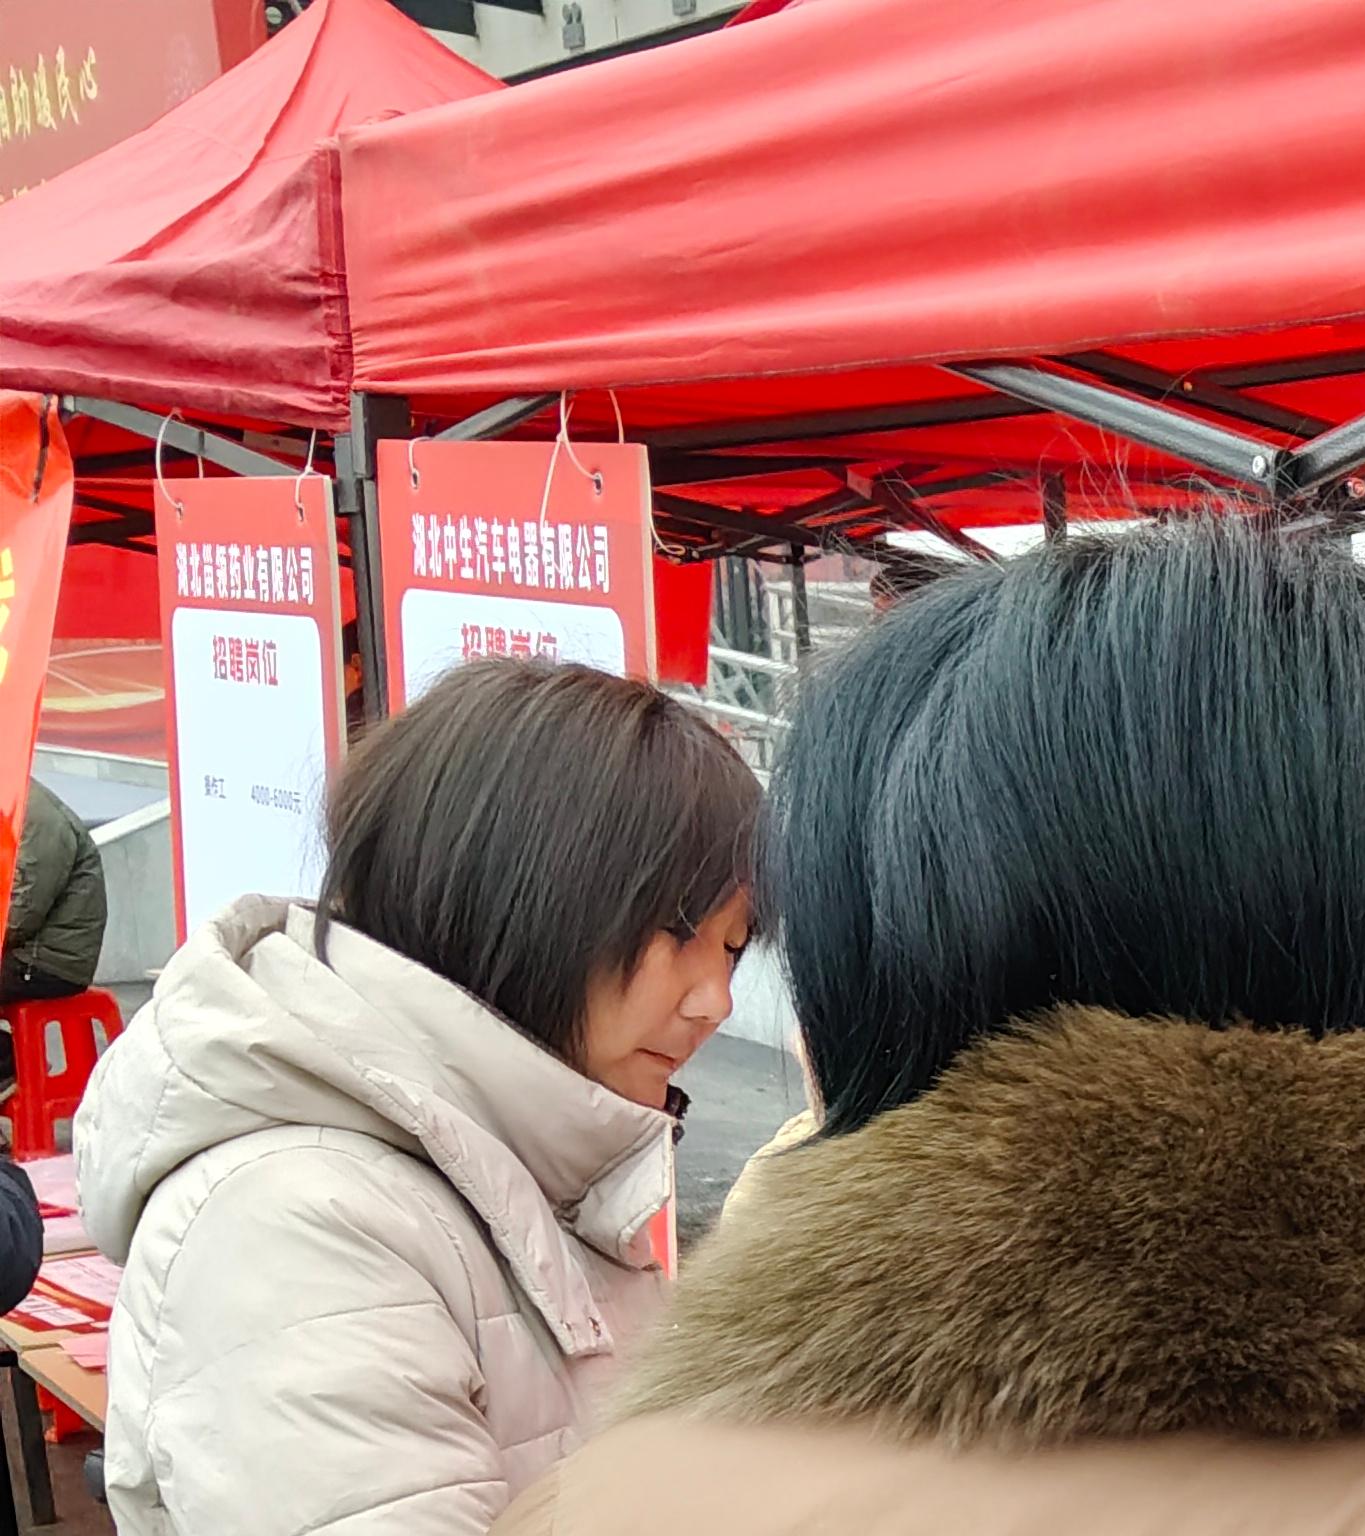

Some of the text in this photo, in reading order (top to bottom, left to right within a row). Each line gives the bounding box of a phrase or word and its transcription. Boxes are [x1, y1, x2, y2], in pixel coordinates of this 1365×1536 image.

[412, 512, 610, 594] 湖北中生汽车电器有限公司
[213, 634, 279, 686] 招聘岗位
